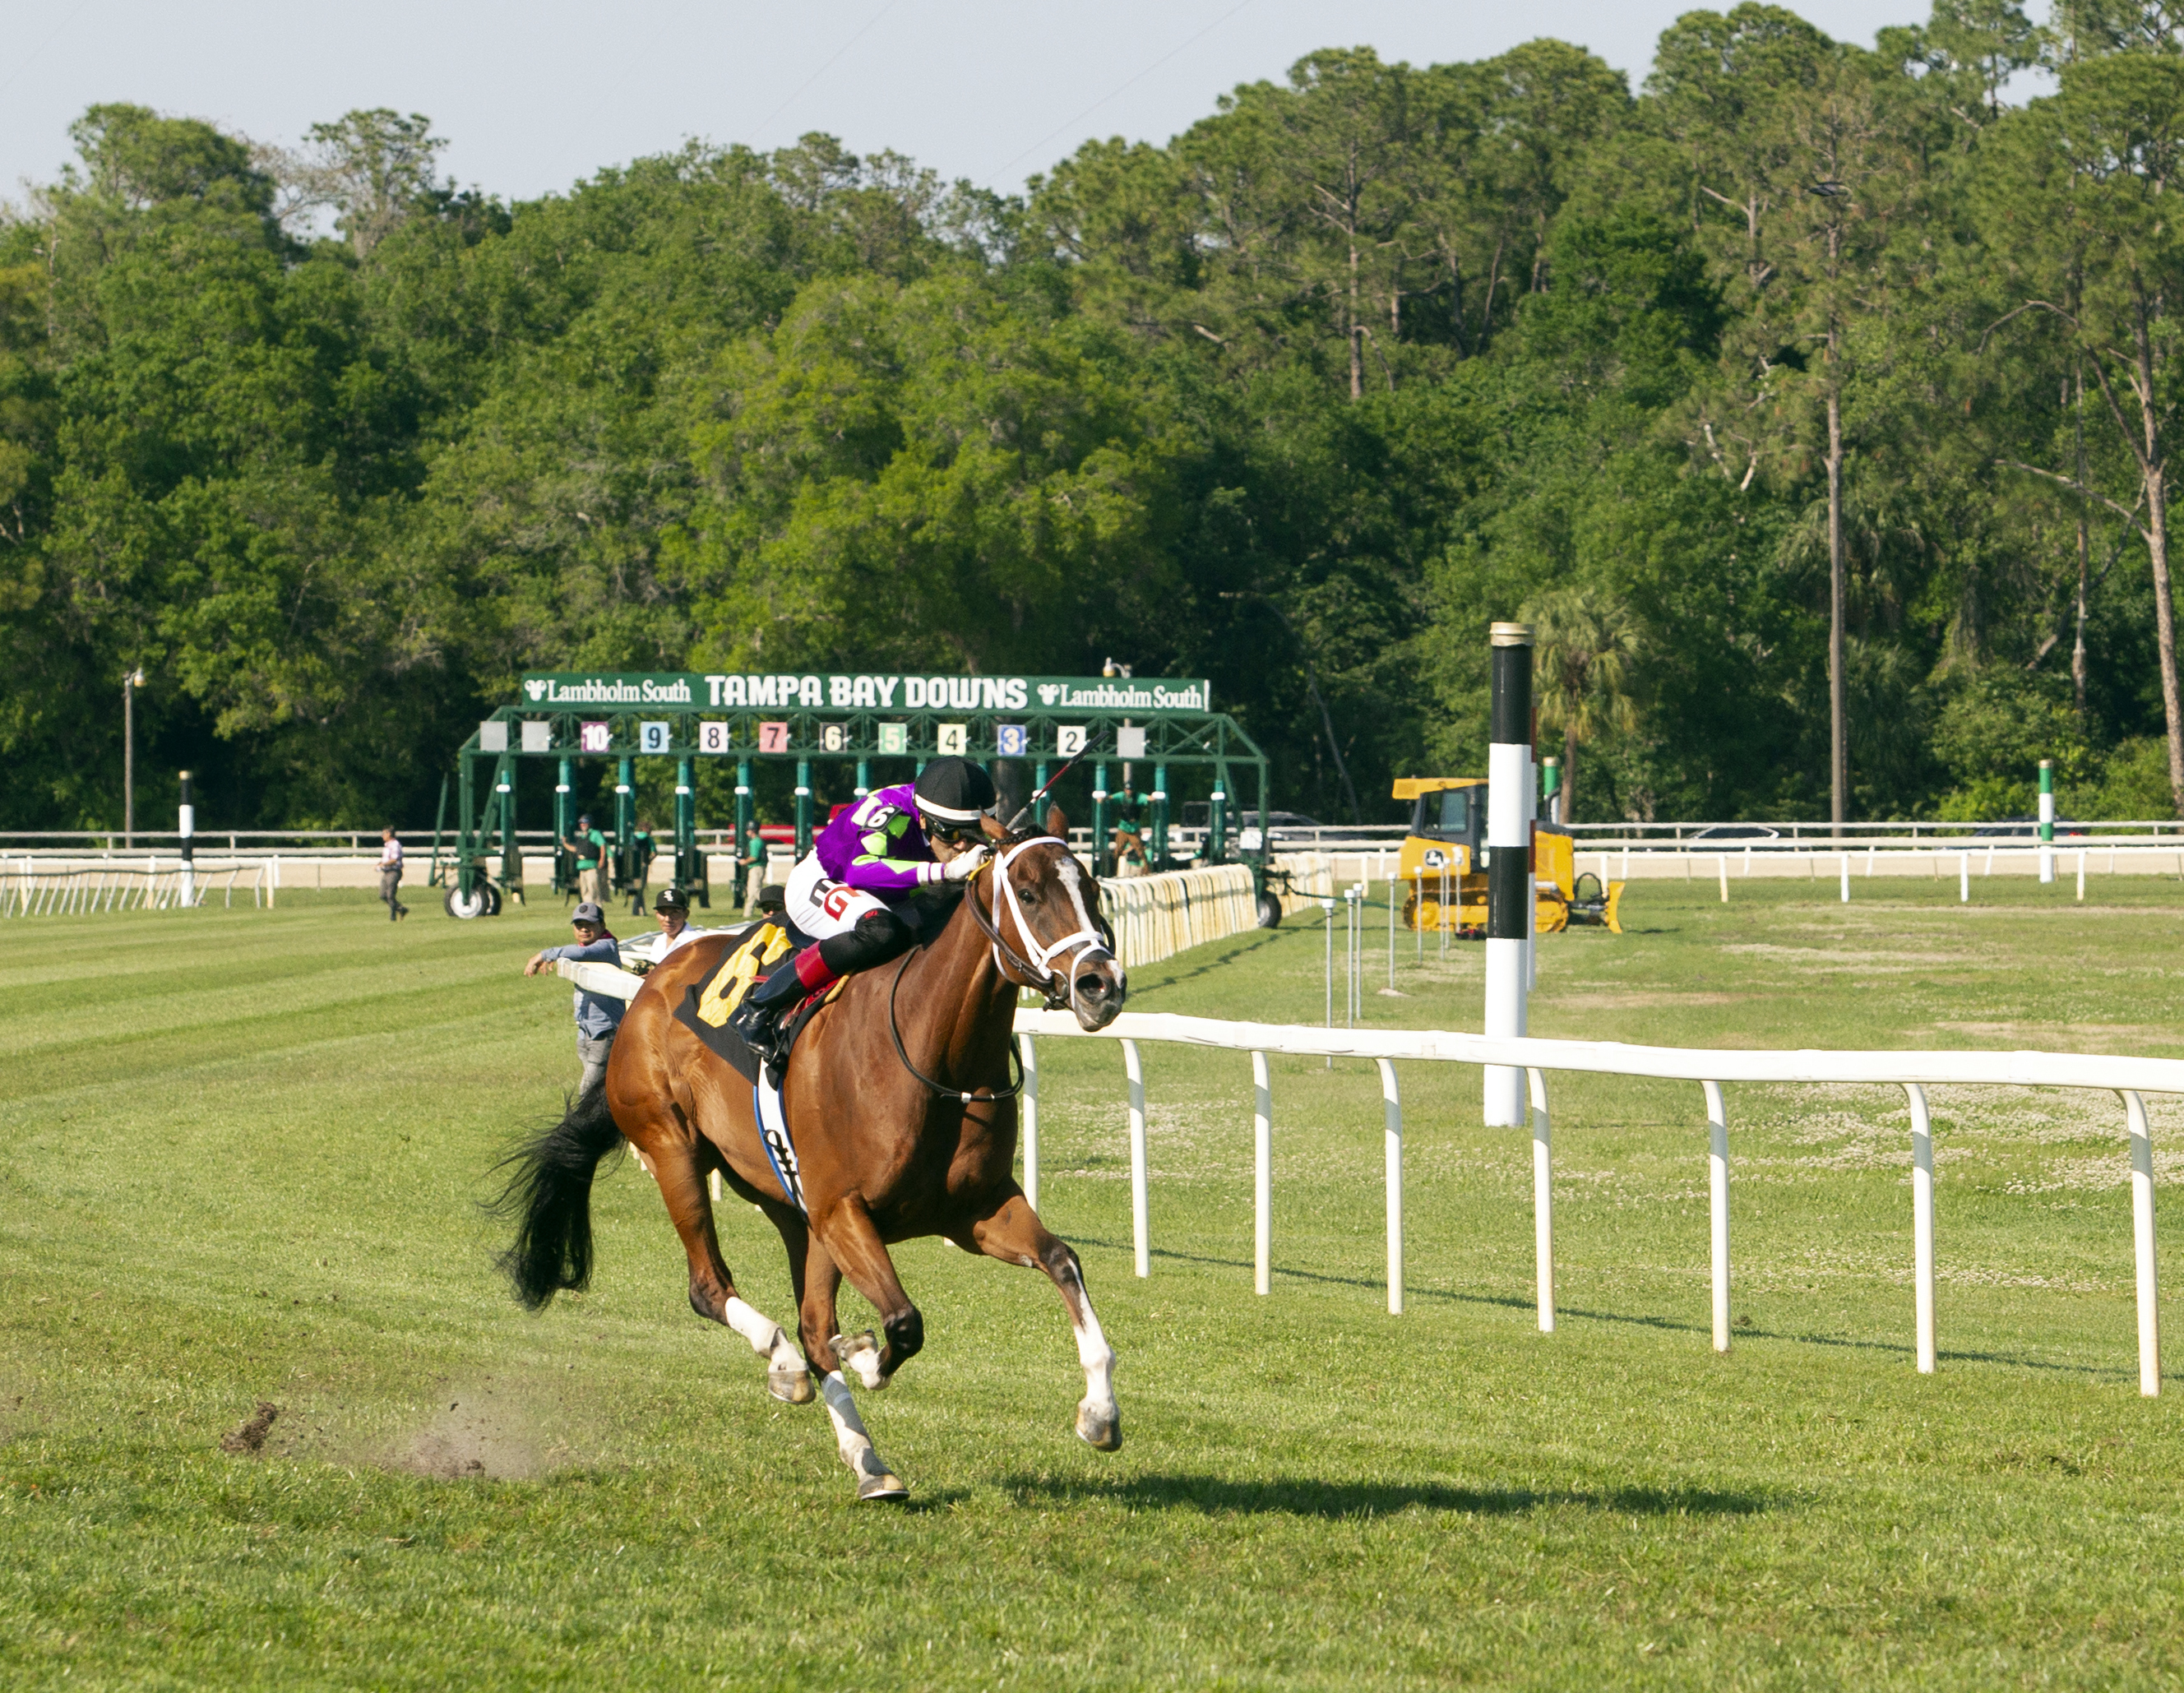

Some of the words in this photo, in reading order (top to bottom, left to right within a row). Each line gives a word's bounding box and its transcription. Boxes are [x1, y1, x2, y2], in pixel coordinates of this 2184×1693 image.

[547, 679, 641, 702] Lambholm
[642, 678, 692, 702] South
[705, 675, 824, 706] TAMPA
[829, 676, 899, 707] BAY
[905, 677, 1028, 710] DOWNS
[1059, 683, 1152, 708] Lambholm
[1154, 684, 1203, 709] South
[582, 724, 608, 751] 10
[648, 727, 661, 749] 9
[707, 727, 720, 749] 8
[767, 727, 780, 748] 7
[825, 725, 841, 752] 6
[885, 727, 900, 752] 5
[946, 729, 958, 750] 4
[1003, 728, 1020, 753] 3
[1066, 731, 1078, 752] 2
[868, 807, 895, 827] 6
[696, 923, 793, 1028] 6
